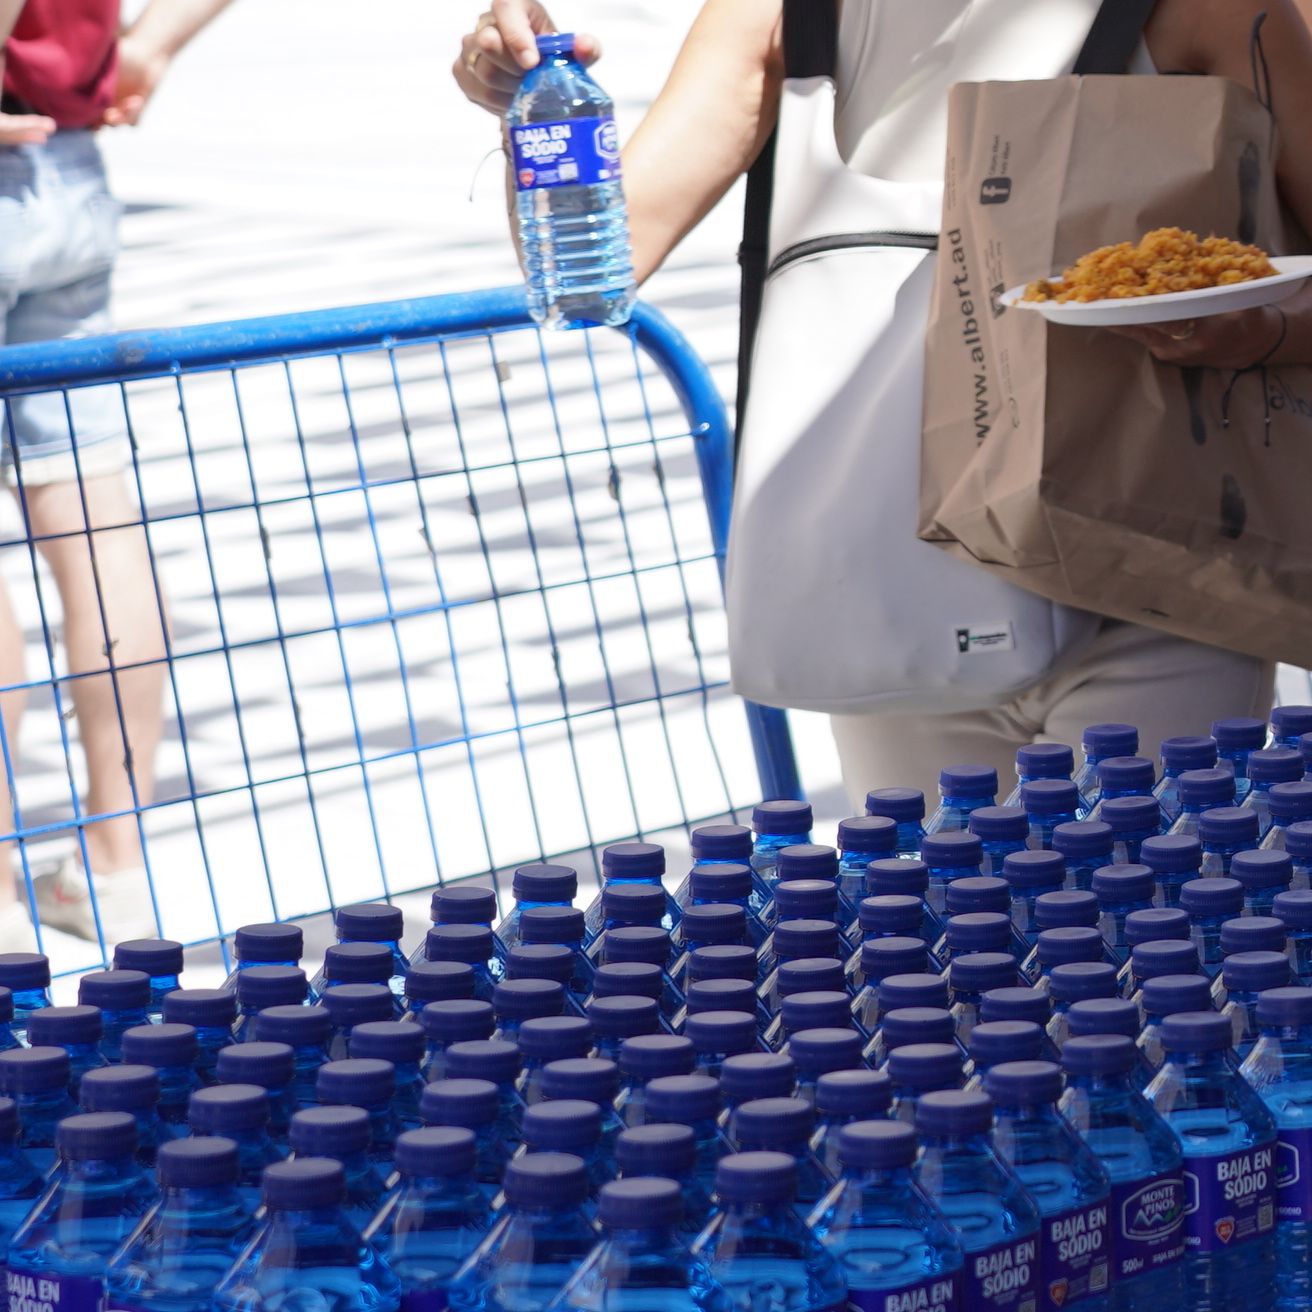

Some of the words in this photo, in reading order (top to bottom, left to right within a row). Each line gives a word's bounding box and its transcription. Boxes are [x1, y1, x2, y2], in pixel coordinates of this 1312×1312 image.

[947, 228, 991, 448] www.albert.ad
[1217, 1156, 1251, 1181] BAJA
[1254, 1149, 1271, 1171] EN
[1141, 1185, 1174, 1205] MONTE
[1224, 1171, 1267, 1200] SODIO
[1146, 1198, 1175, 1215] PINOS
[1051, 1215, 1086, 1244] BAJA
[1088, 1206, 1107, 1228] EN
[975, 1249, 1012, 1280] BAJA
[1016, 1240, 1036, 1263] EN
[1058, 1231, 1103, 1262] SODIO
[887, 1287, 927, 1312] BAJA
[932, 1279, 953, 1301] EN
[983, 1265, 1030, 1299] SODIO
